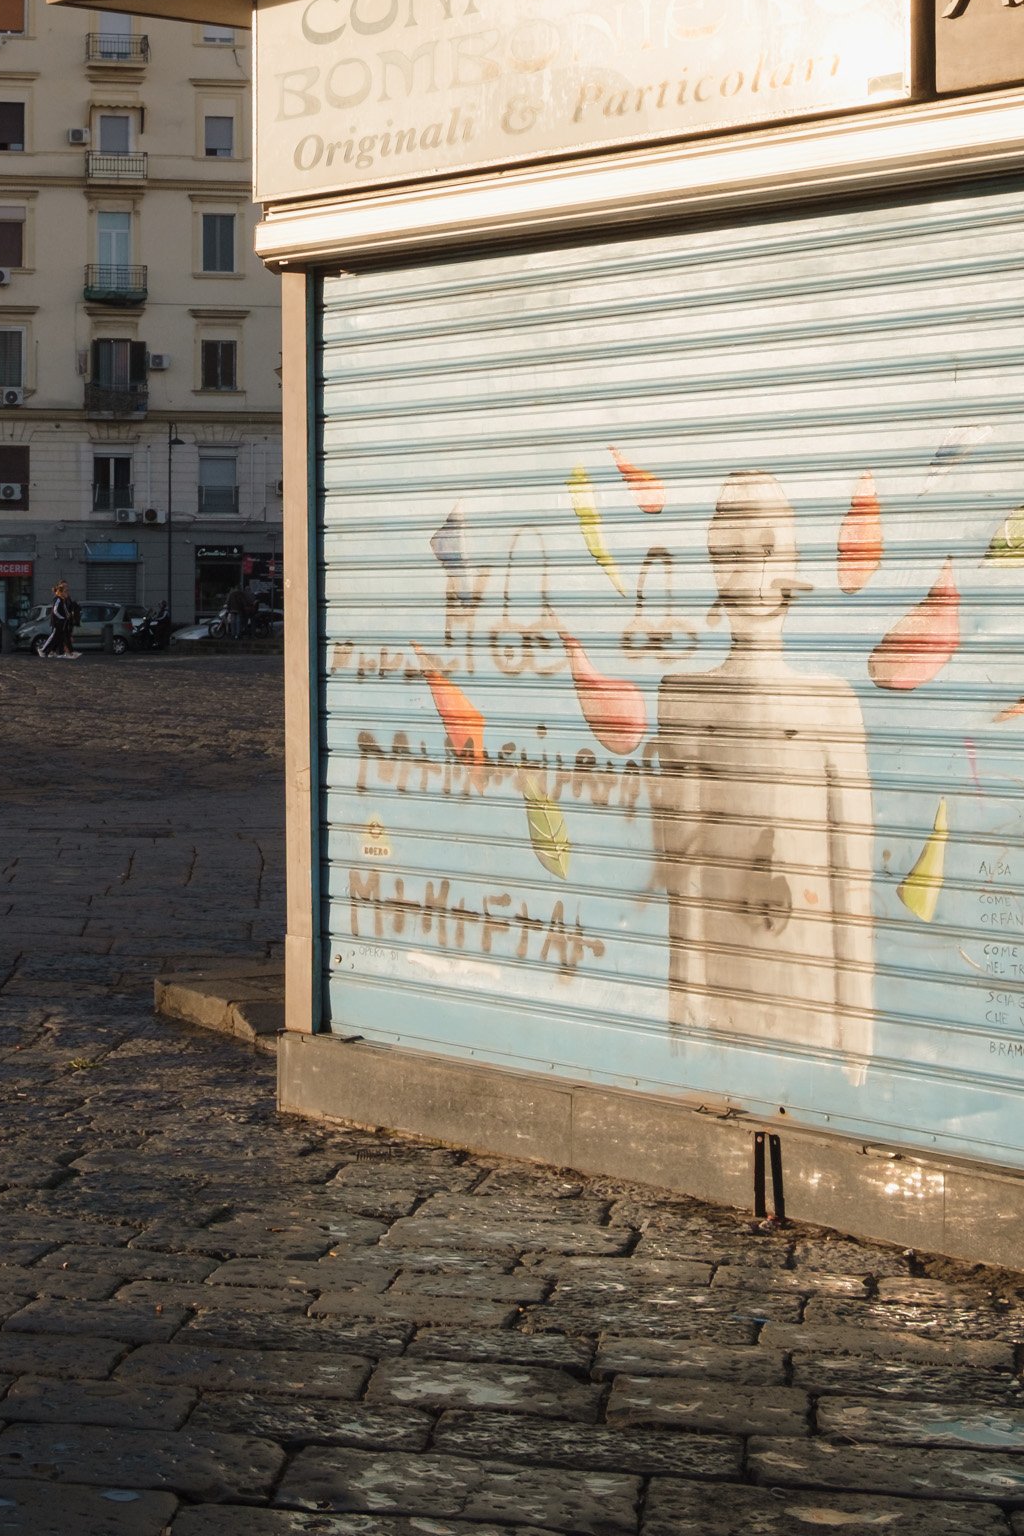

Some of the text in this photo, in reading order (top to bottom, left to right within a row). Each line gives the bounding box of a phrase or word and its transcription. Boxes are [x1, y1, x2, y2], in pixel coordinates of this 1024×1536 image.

[292, 48, 844, 173] Originali & Particolari
[364, 846, 389, 856] BOERO
[979, 860, 1011, 876] ALBA
[979, 895, 1012, 907] COME
[983, 944, 1018, 958] COME
[986, 962, 1005, 976] NEL
[985, 1010, 1009, 1025] CHE
[989, 1041, 1024, 1058] BRAM
